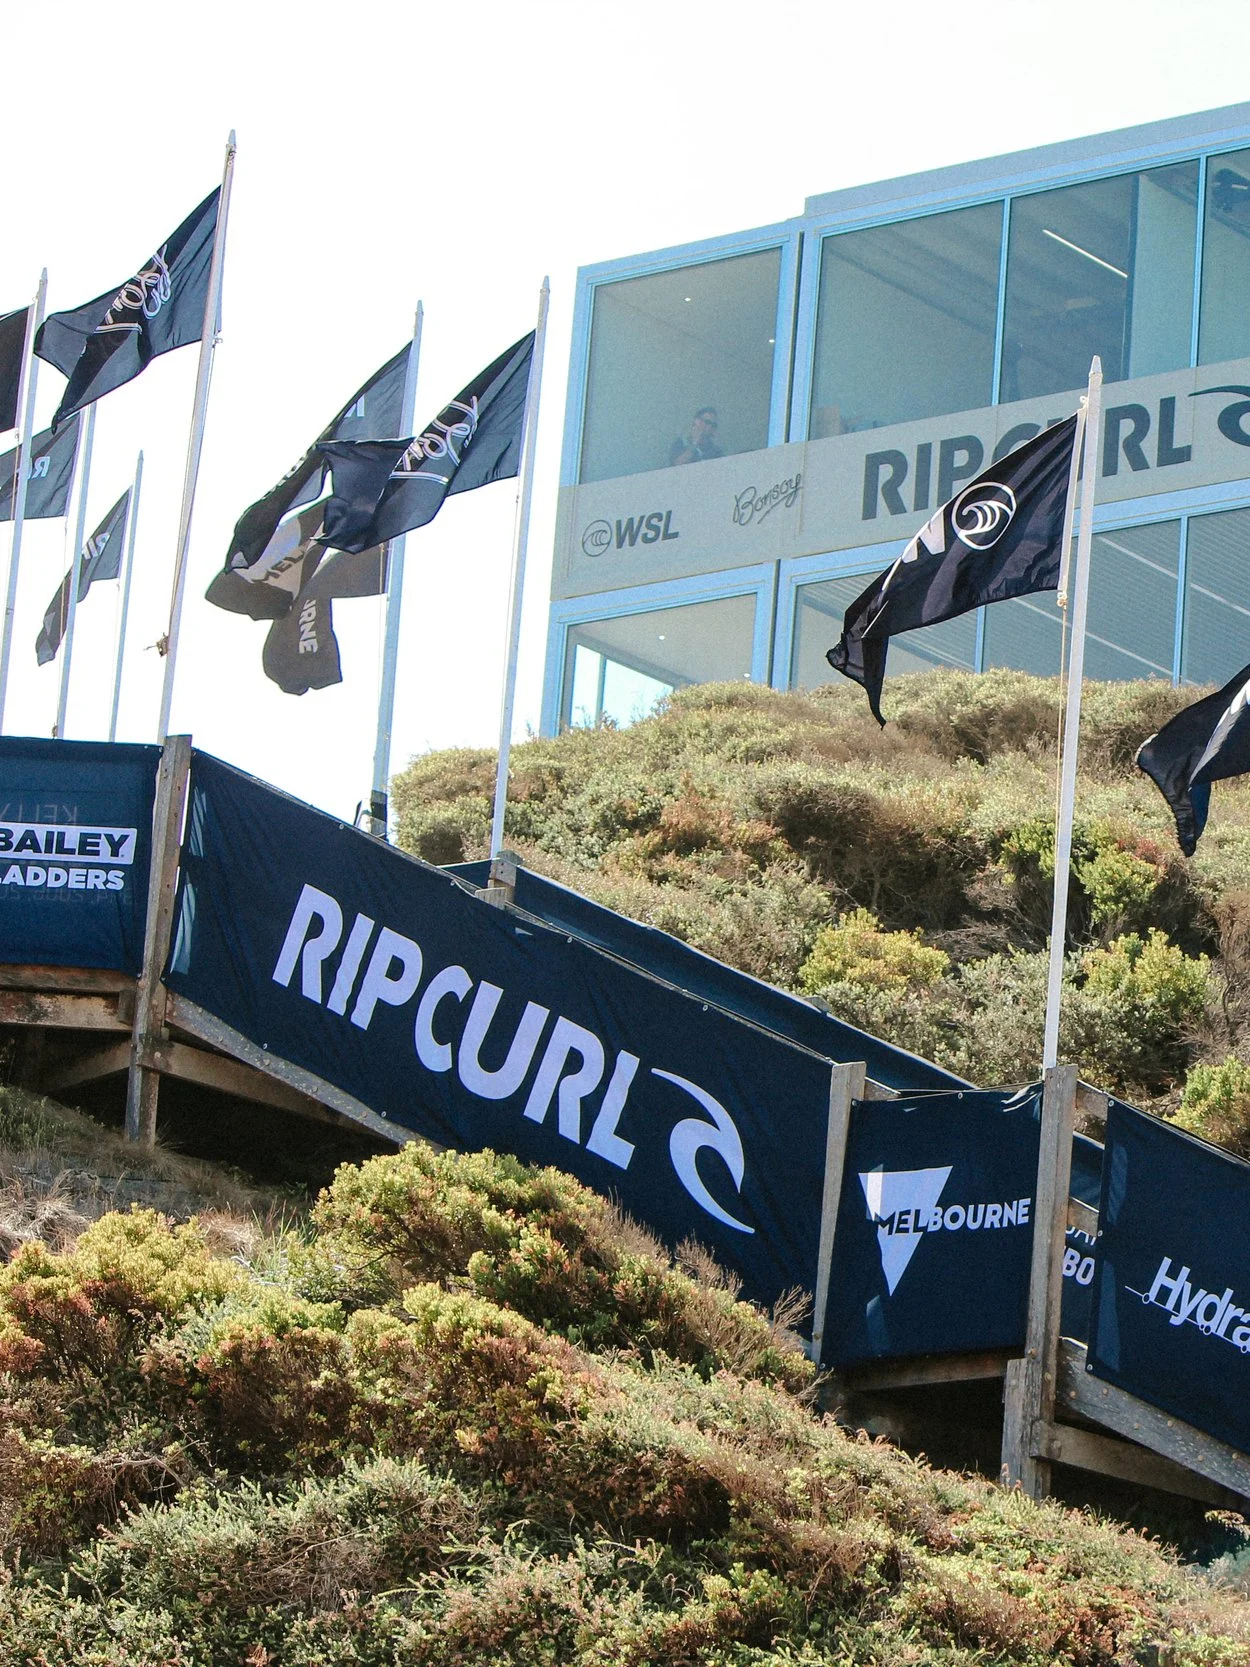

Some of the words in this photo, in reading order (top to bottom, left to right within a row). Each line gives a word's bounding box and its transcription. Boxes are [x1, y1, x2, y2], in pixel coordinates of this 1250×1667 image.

[861, 396, 1192, 521] RIPCRL
[732, 473, 804, 526] Bonsoy
[615, 510, 680, 549] WSL
[0, 864, 125, 890] ADDERS
[273, 884, 640, 1170] RIPCURL
[874, 1198, 1031, 1236] MELBOURNE
